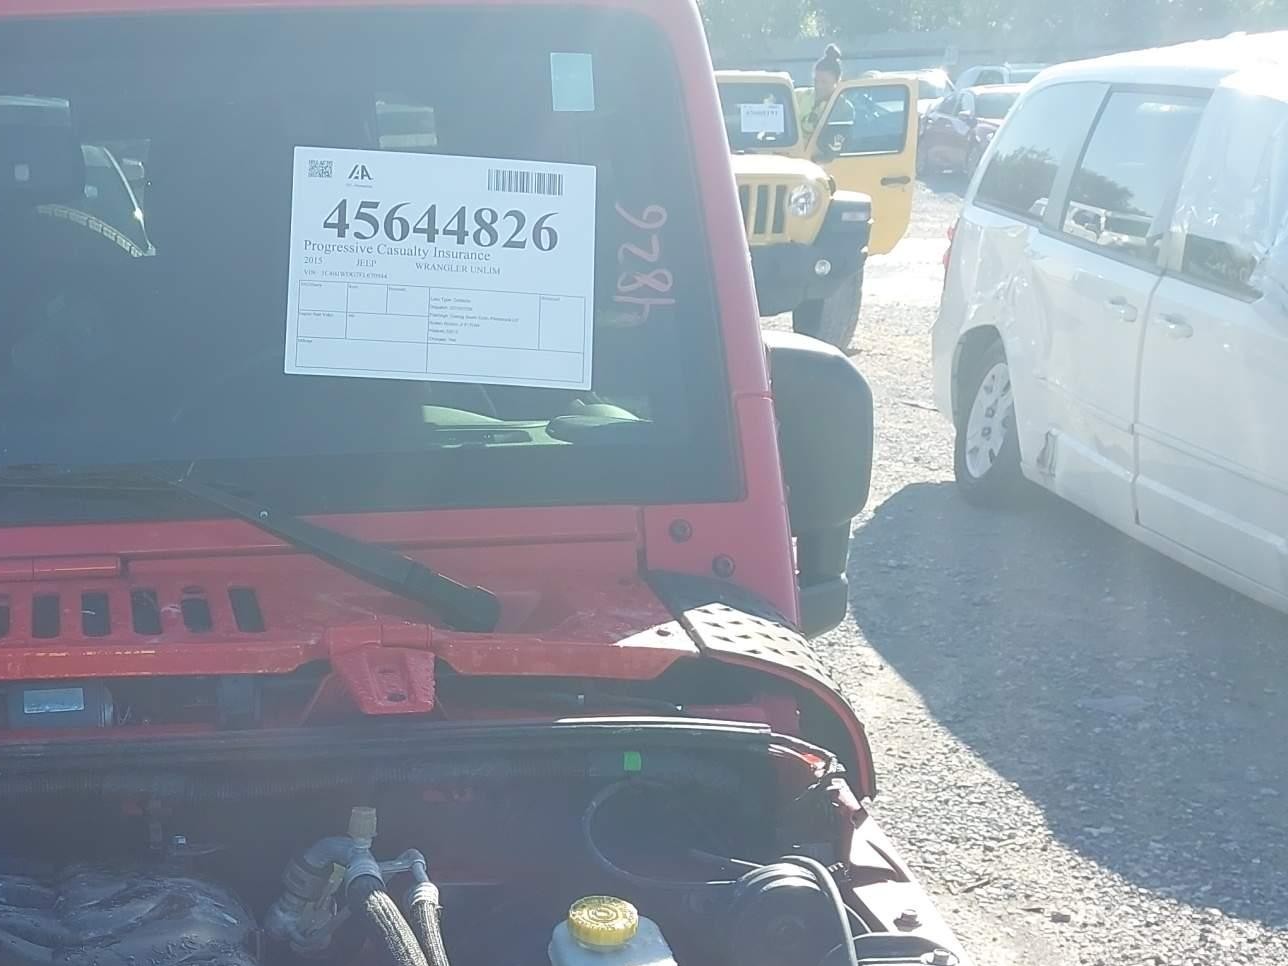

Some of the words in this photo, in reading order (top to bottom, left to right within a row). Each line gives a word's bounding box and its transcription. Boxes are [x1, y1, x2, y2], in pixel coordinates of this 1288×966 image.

[322, 199, 560, 252] 45644826
[303, 239, 374, 255] Progressive
[376, 243, 430, 260] Casualty
[432, 246, 491, 261] Insurance
[303, 256, 324, 265] 2015
[355, 258, 378, 268] JEEP
[415, 262, 469, 274] WRANGLER
[470, 266, 501, 276] UNLIM
[611, 202, 676, 326] 4826
